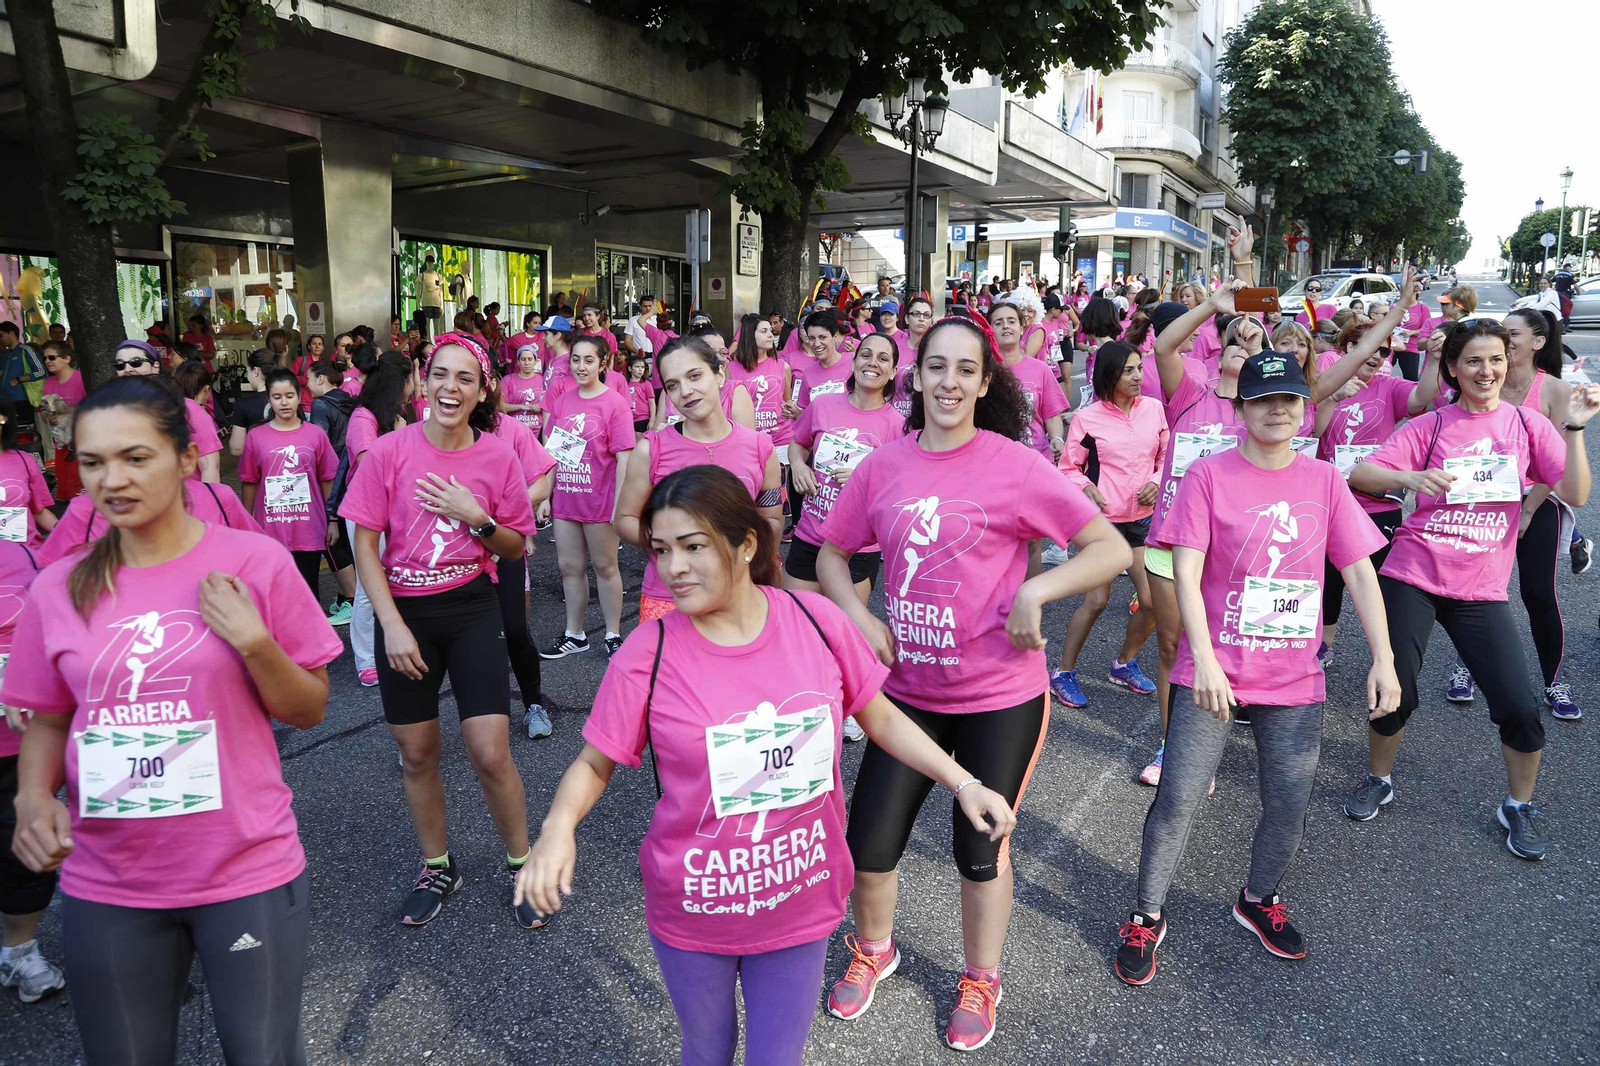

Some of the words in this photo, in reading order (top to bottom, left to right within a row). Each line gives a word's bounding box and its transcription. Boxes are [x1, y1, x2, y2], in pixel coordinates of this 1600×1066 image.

[953, 227, 963, 240] P
[834, 450, 850, 463] 214
[1472, 470, 1492, 482] 434
[282, 484, 294, 492] 354
[1430, 509, 1508, 527] CARRERA
[1424, 522, 1507, 542] FEMENINA
[1273, 599, 1298, 614] 1340
[1291, 640, 1307, 648] VIGO
[938, 656, 959, 666] VIGO
[760, 746, 794, 772] 702
[127, 756, 164, 778] 700
[683, 818, 827, 876] CARRERA
[683, 843, 827, 898] FEMENINA
[702, 900, 746, 915] Corte
[806, 870, 830, 888] VIGO
[230, 940, 262, 952] adidas
